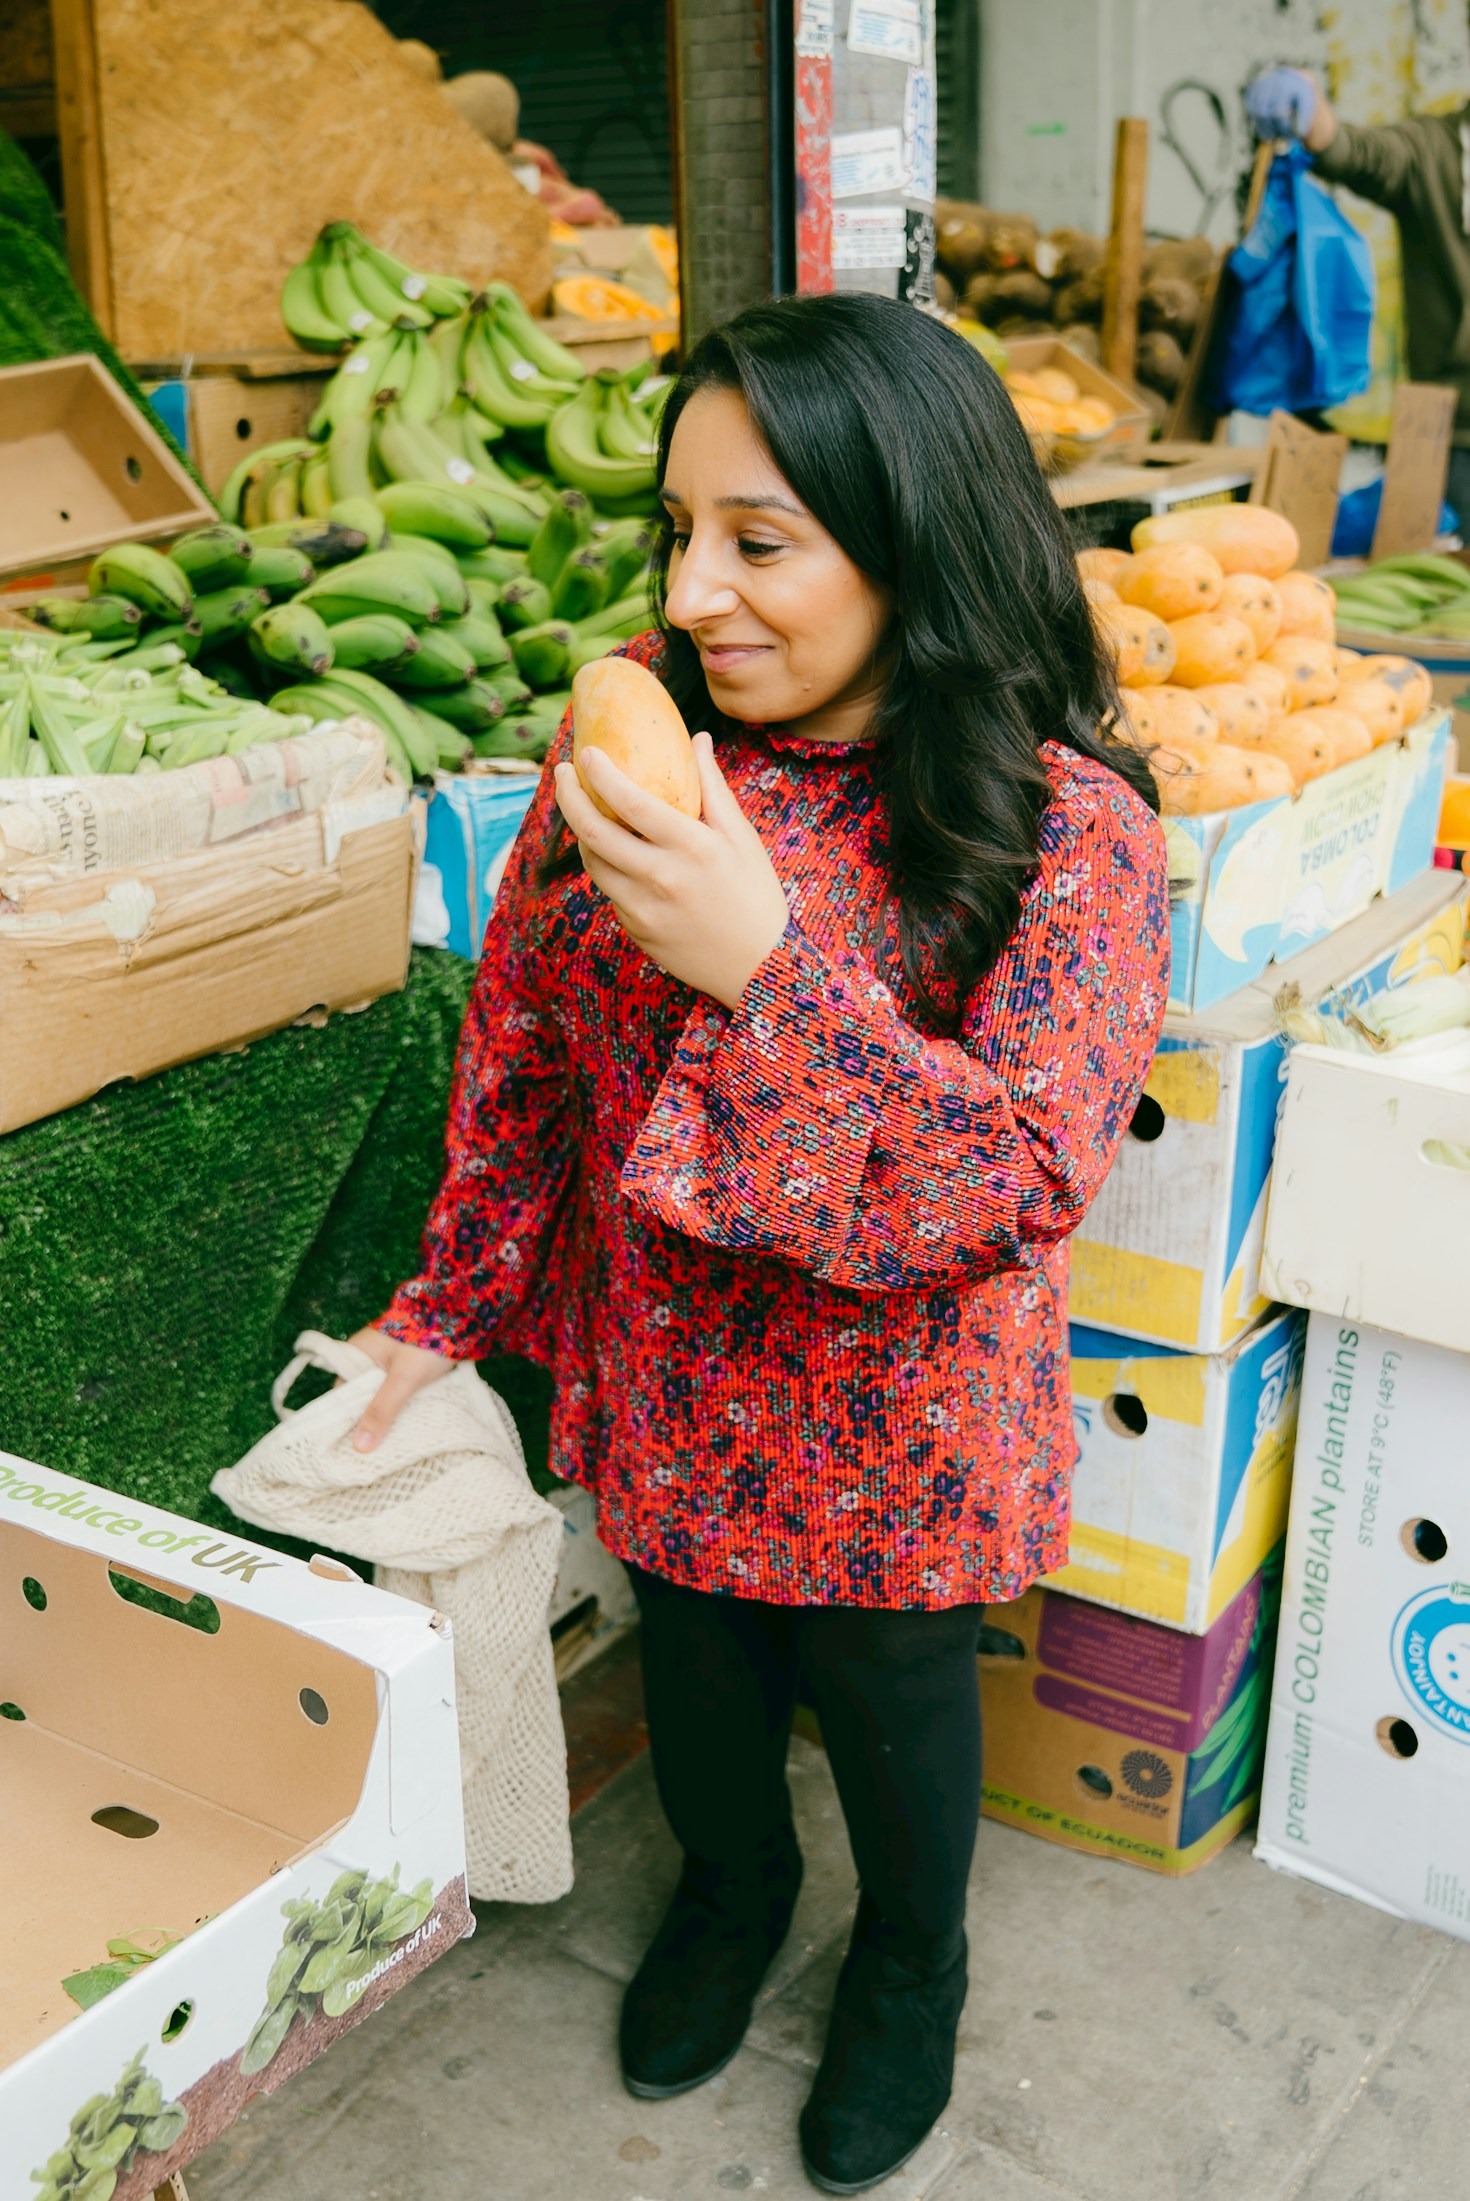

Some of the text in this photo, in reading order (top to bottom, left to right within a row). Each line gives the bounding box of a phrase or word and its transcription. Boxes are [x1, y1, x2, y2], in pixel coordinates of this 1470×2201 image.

[1367, 1456, 1384, 1479] AT
[0, 1465, 283, 1584] Produce of UK
[1358, 1480, 1380, 1547] STORE
[1285, 1328, 1359, 1845] premium COLOMBIAN plantains
[1202, 1593, 1255, 1730] PLANTAINS
[1060, 1818, 1164, 1859] ECUADOR
[346, 1913, 442, 2000] Produce of UK
